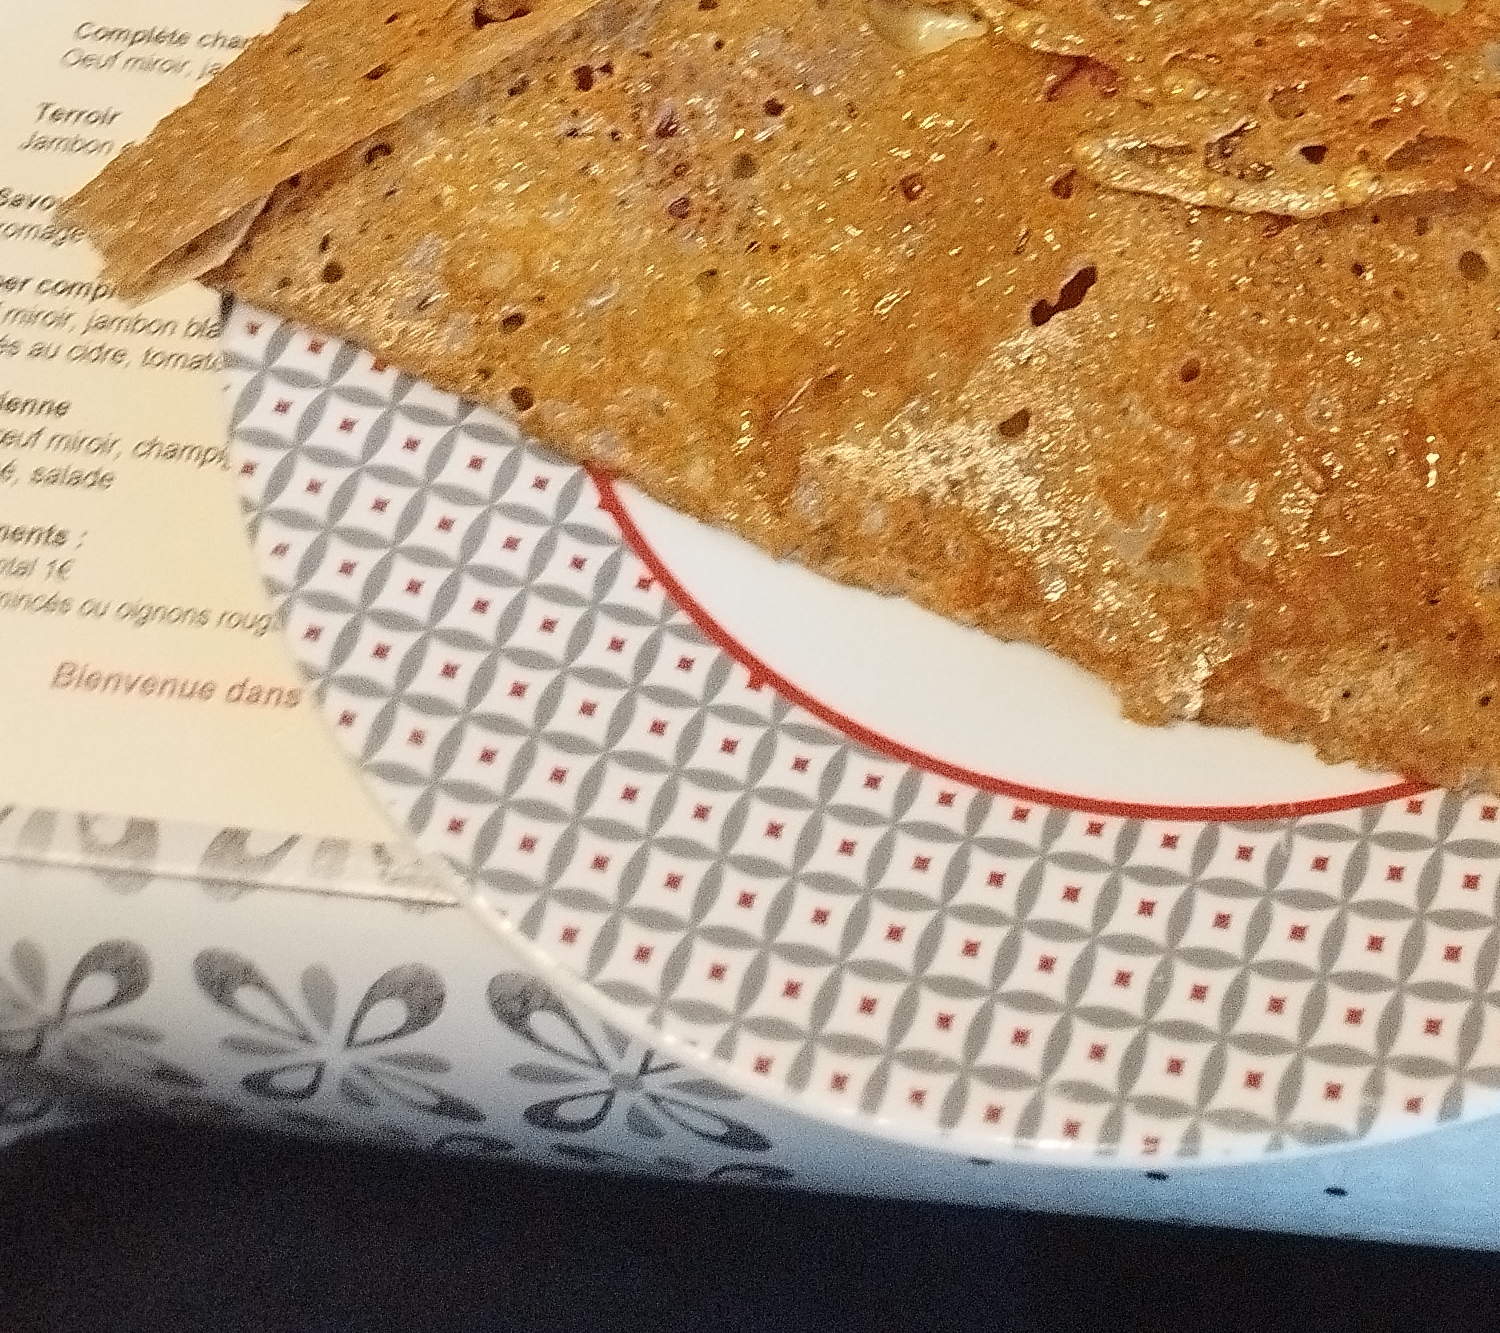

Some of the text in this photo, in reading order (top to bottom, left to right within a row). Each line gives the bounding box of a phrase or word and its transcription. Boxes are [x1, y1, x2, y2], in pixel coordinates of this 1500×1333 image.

[74, 20, 192, 49] Complète
[35, 101, 124, 128] Terroir
[17, 131, 116, 158] Jambon
[81, 312, 178, 338] jambon
[26, 338, 62, 360] au
[65, 341, 132, 370] cidre,
[29, 463, 117, 491] salade
[44, 556, 76, 582] 1€
[77, 595, 213, 631] ou oignons
[51, 658, 304, 709] Bienvenue dans
